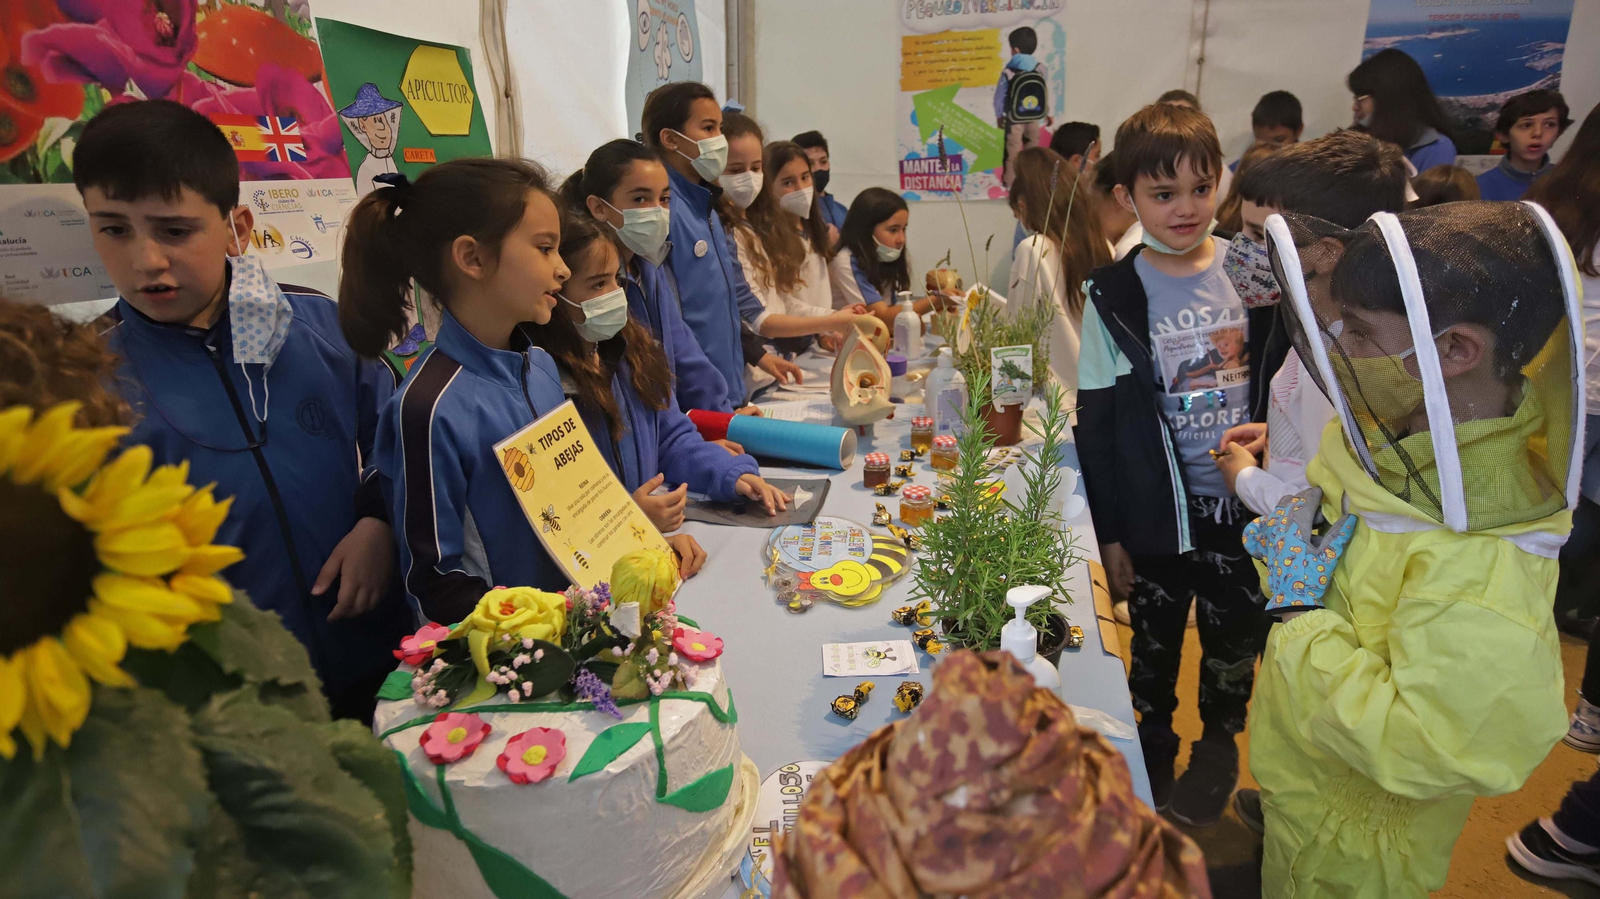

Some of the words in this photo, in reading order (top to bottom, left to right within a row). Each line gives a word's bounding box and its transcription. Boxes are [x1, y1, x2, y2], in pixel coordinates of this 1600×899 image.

[407, 79, 471, 104] APICULTOR
[404, 149, 435, 160] CARETA
[951, 162, 960, 171] LA
[904, 174, 962, 189] DISTANCIA
[268, 188, 299, 199] IBERO
[317, 189, 334, 197] UCA
[271, 203, 303, 211] CIENCIAS
[62, 266, 93, 278] UCA
[1154, 306, 1246, 336] NOSA
[538, 425, 565, 451] TIPOS
[564, 417, 577, 435] DE
[1175, 430, 1216, 440] FFICIAL
[553, 440, 584, 470] ABEJAS
[579, 479, 589, 489] REINA
[599, 508, 611, 521] OBRERA
[818, 521, 834, 529] DE
[833, 530, 848, 544] LAS
[818, 531, 834, 556] MUNDO
